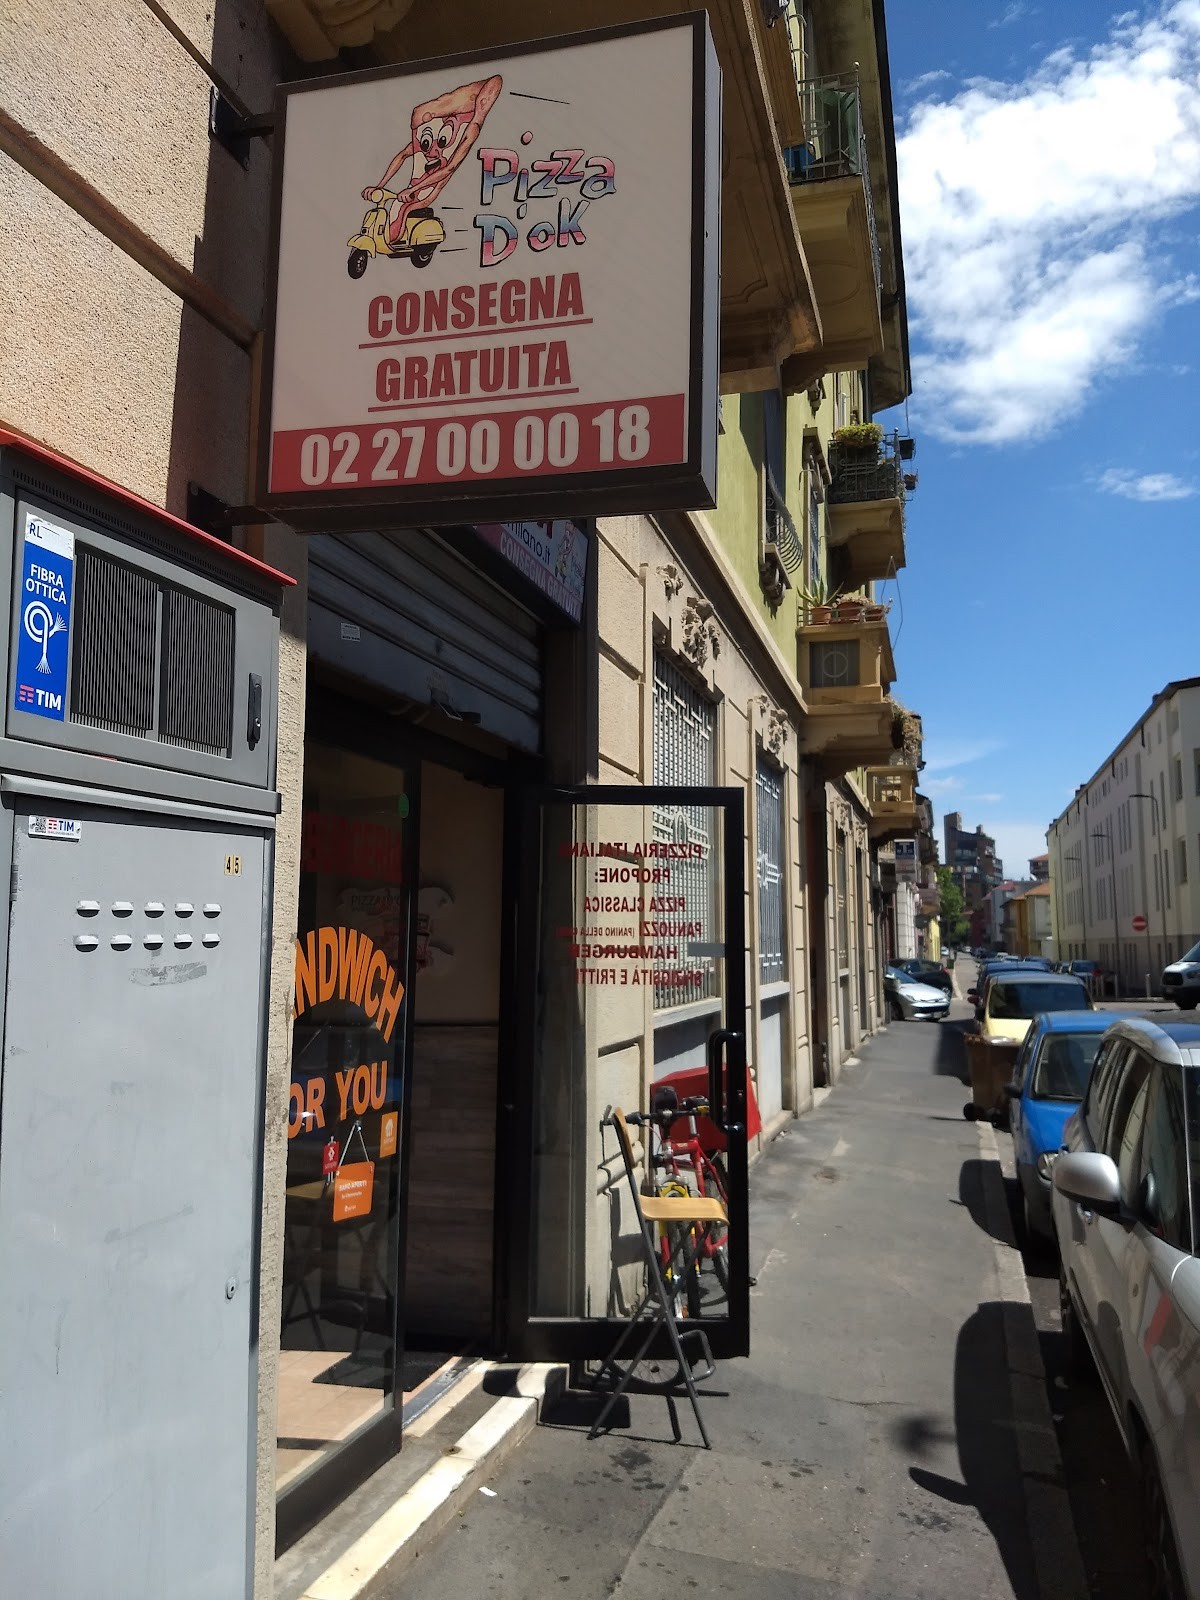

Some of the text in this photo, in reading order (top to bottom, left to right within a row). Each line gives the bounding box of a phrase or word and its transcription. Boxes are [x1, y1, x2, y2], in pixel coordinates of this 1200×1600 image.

[477, 131, 617, 206] Pizza
[368, 272, 584, 339] CONSEGNA
[375, 340, 572, 402] GRATUITA
[301, 405, 650, 487] 02 27 00 00 18
[29, 522, 43, 539] RL
[26, 578, 67, 605] OTTICA
[30, 563, 64, 588] FIBRA
[500, 531, 547, 592] CONSEGNA
[36, 689, 62, 711] TIM
[58, 820, 75, 832] TIM
[335, 1060, 387, 1120] YOU
